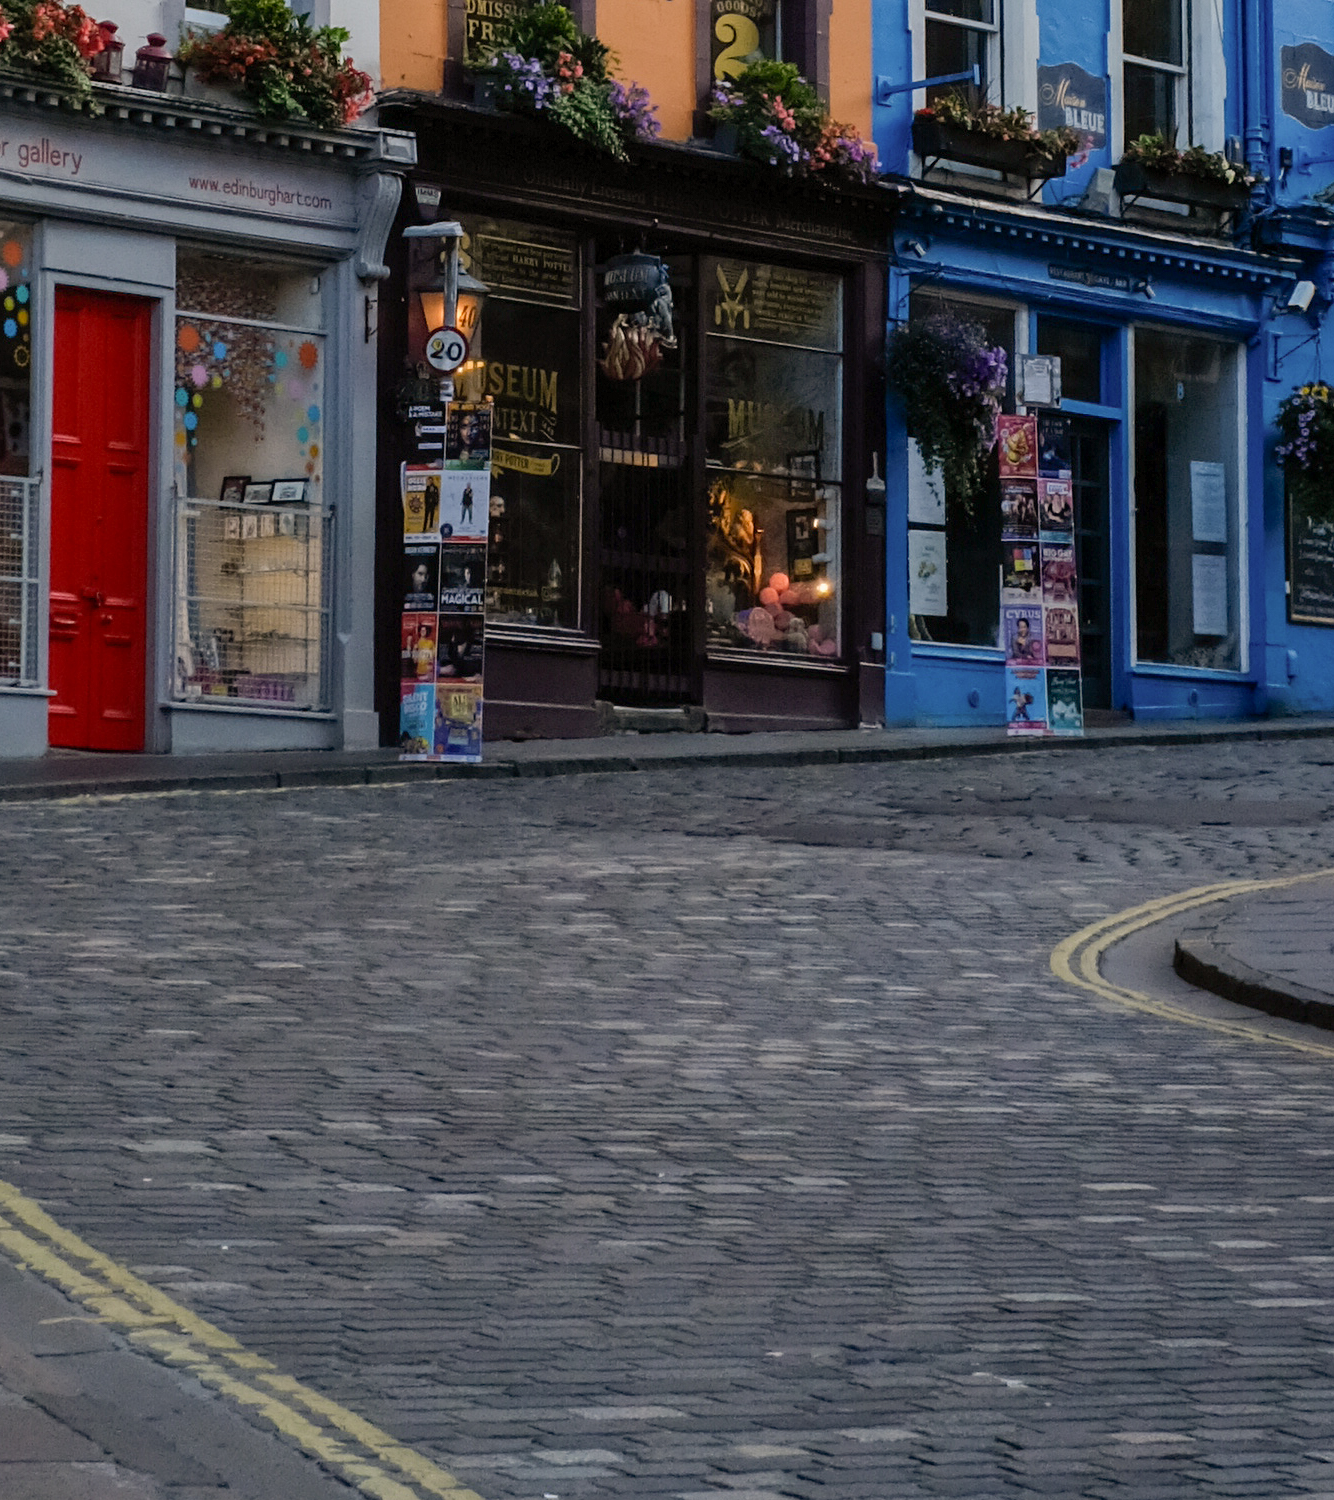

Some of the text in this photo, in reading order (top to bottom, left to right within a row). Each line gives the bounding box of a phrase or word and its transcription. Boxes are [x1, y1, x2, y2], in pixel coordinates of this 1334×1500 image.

[466, 0, 528, 19] DMISSIO
[1064, 107, 1106, 134] BLEUE
[17, 137, 83, 175] gallery
[458, 304, 476, 328] 40
[429, 341, 463, 362] 20
[503, 452, 530, 469] POTTER
[440, 593, 484, 606] MAGICAL
[1005, 609, 1042, 619] CYRUS
